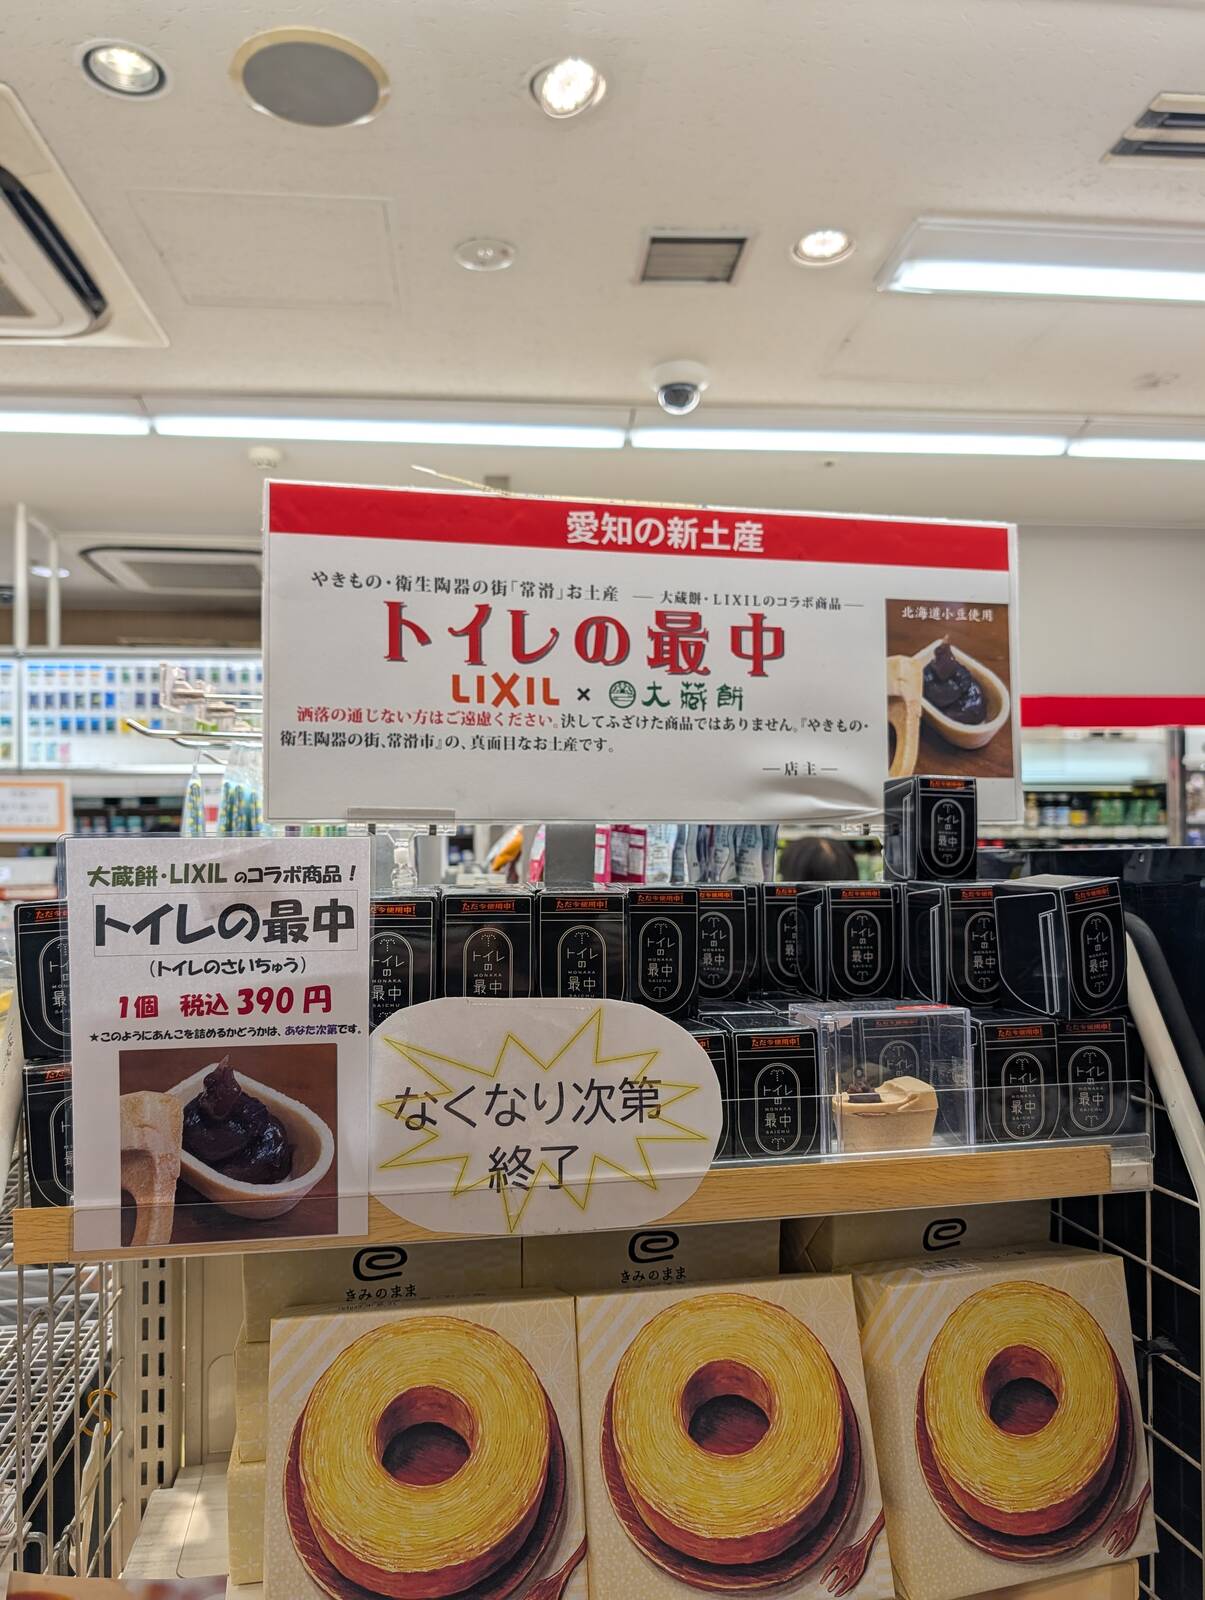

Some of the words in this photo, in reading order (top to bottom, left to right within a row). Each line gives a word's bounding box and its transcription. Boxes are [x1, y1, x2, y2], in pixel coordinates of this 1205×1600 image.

[567, 510, 764, 553] 愛知の新土産
[312, 571, 618, 602] やきもの・衛生陶器の街「常滑」お土産
[901, 606, 993, 622] 北海道小豆使用
[383, 600, 785, 677] トイレの最中
[452, 672, 560, 708] LIXIL
[95, 898, 354, 947] トイレの最中
[701, 930, 727, 940] トイレ
[850, 928, 875, 938] トイレ
[971, 930, 997, 941] トイレ
[1086, 931, 1109, 945] トイレ
[647, 937, 676, 949] トイレ
[473, 950, 505, 962] トイレ
[567, 947, 599, 959] トイレ
[703, 953, 725, 966] 最中
[852, 951, 874, 964] 最中
[371, 954, 405, 967] トイレ
[973, 955, 996, 969] 最中
[1089, 958, 1109, 973] 最中
[648, 963, 673, 977] 最中
[473, 979, 502, 995] 最中
[567, 976, 596, 992] 最中
[371, 984, 402, 1002] 最中
[119, 994, 159, 1019] 1個
[1010, 1073, 1037, 1084] トイレ
[1076, 1066, 1105, 1077] トイレ
[763, 1085, 793, 1097] トイレ
[395, 1076, 662, 1131] なくなり次第
[1079, 1092, 1104, 1105] 最中
[1011, 1100, 1036, 1114] 最中
[765, 1113, 792, 1128] 最中
[488, 1145, 579, 1194] 終了
[620, 1266, 687, 1284] きみのまま
[345, 1283, 417, 1302] きみのまま
